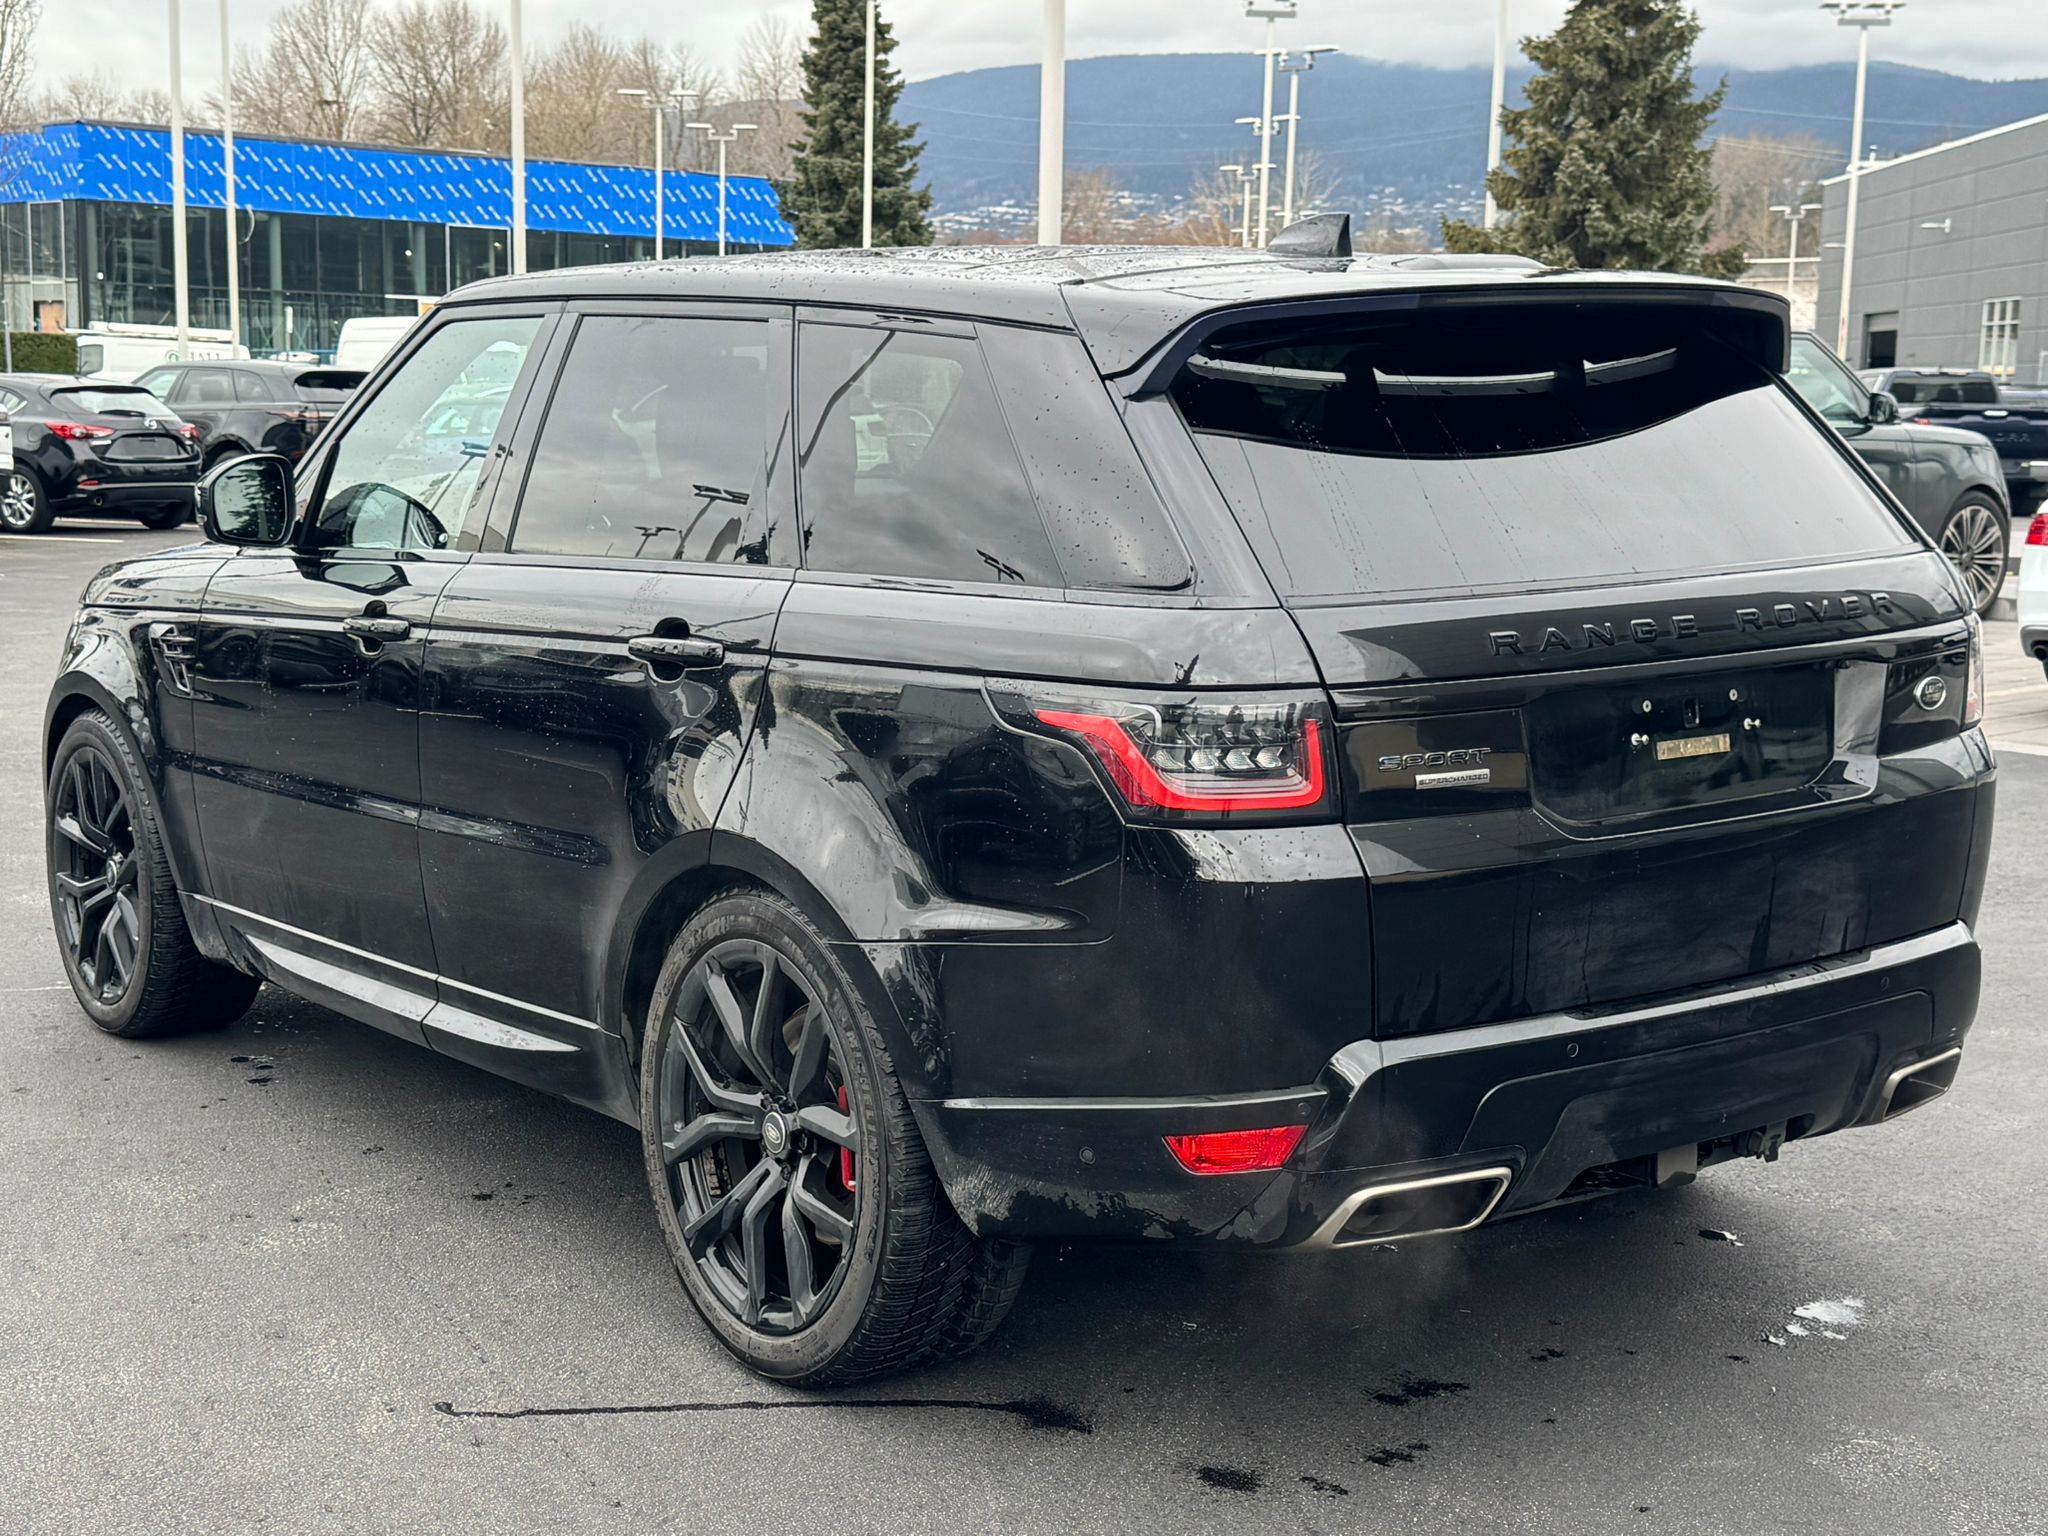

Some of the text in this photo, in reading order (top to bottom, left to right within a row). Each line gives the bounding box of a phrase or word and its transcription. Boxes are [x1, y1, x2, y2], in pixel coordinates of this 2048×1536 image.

[1488, 592, 1895, 656] RANGE ROVER
[1378, 747, 1492, 772] SPORT
[845, 1030, 878, 1155] MICHELIN
